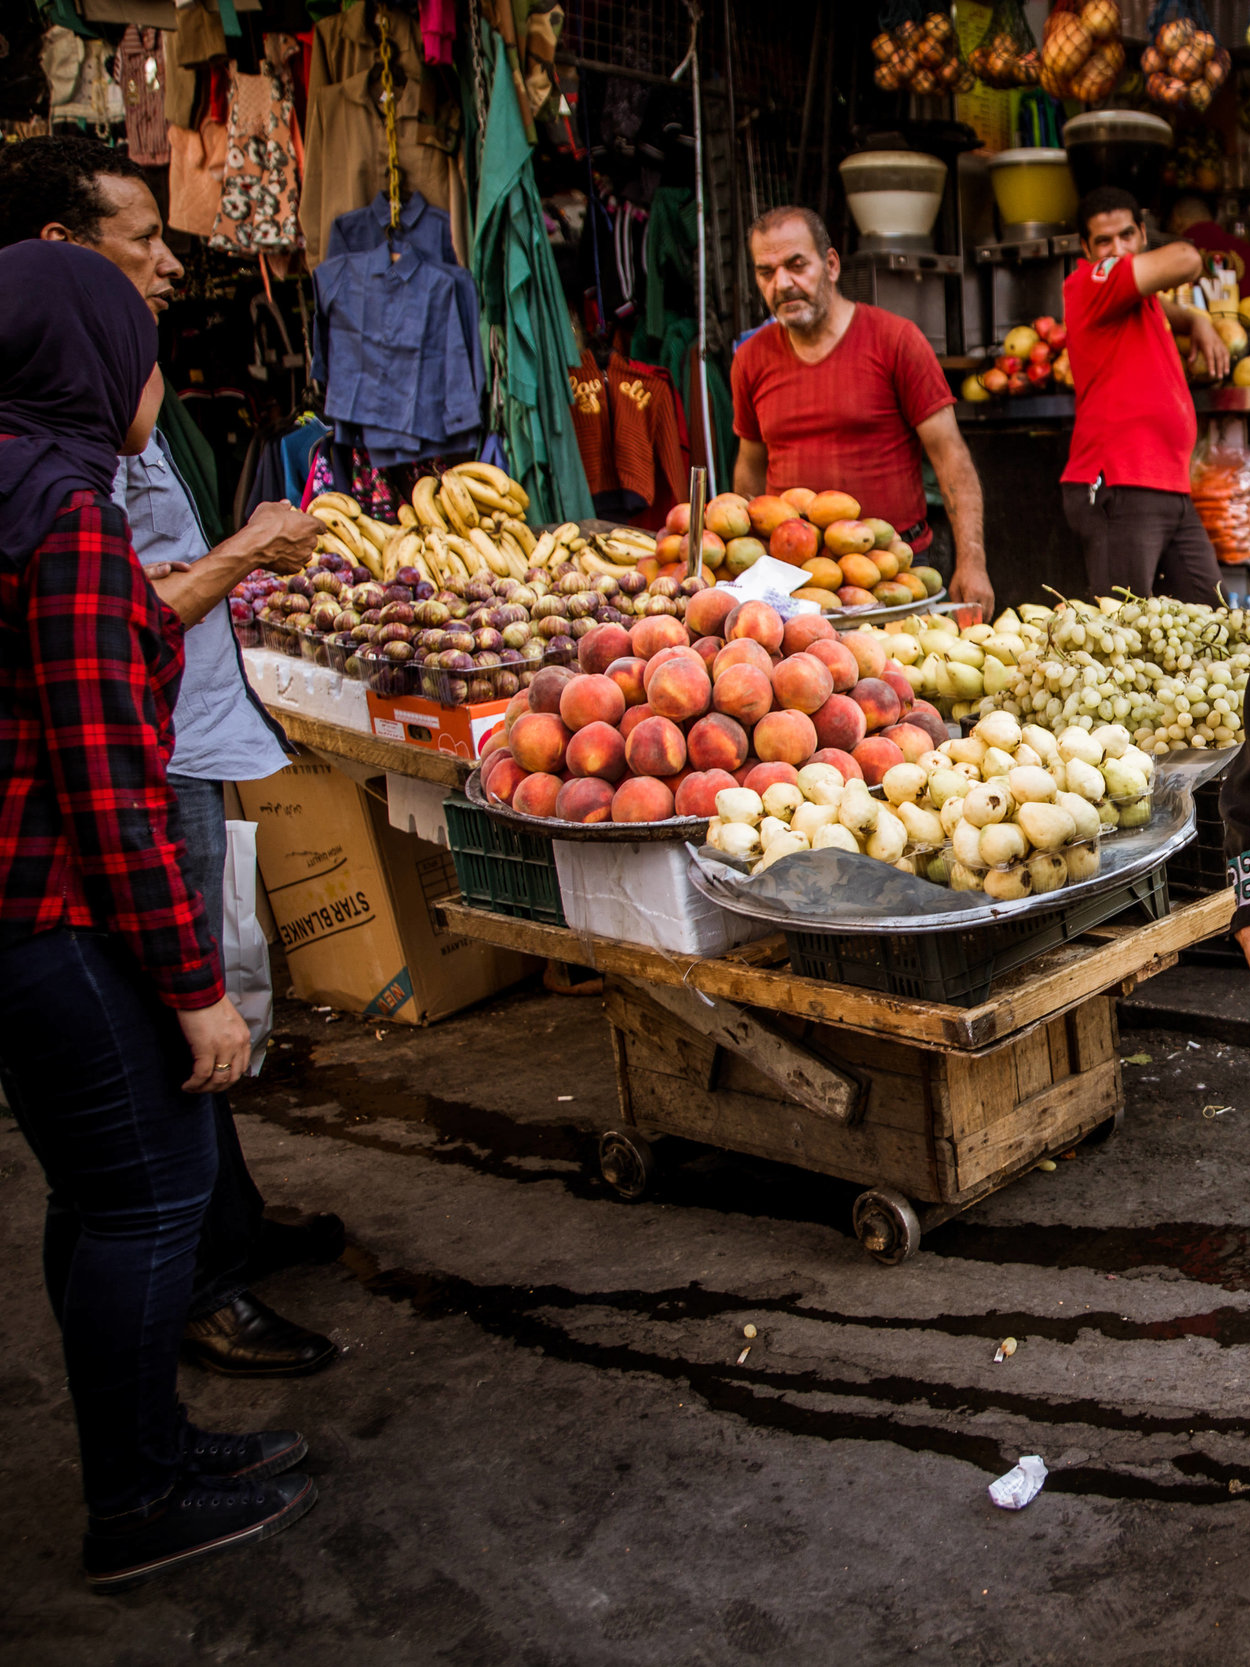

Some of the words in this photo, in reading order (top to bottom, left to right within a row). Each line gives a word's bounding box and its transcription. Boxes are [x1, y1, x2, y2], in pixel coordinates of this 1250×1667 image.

[329, 891, 371, 924] STAR
[280, 909, 334, 947] BLANKE
[377, 981, 405, 1015] NEW
